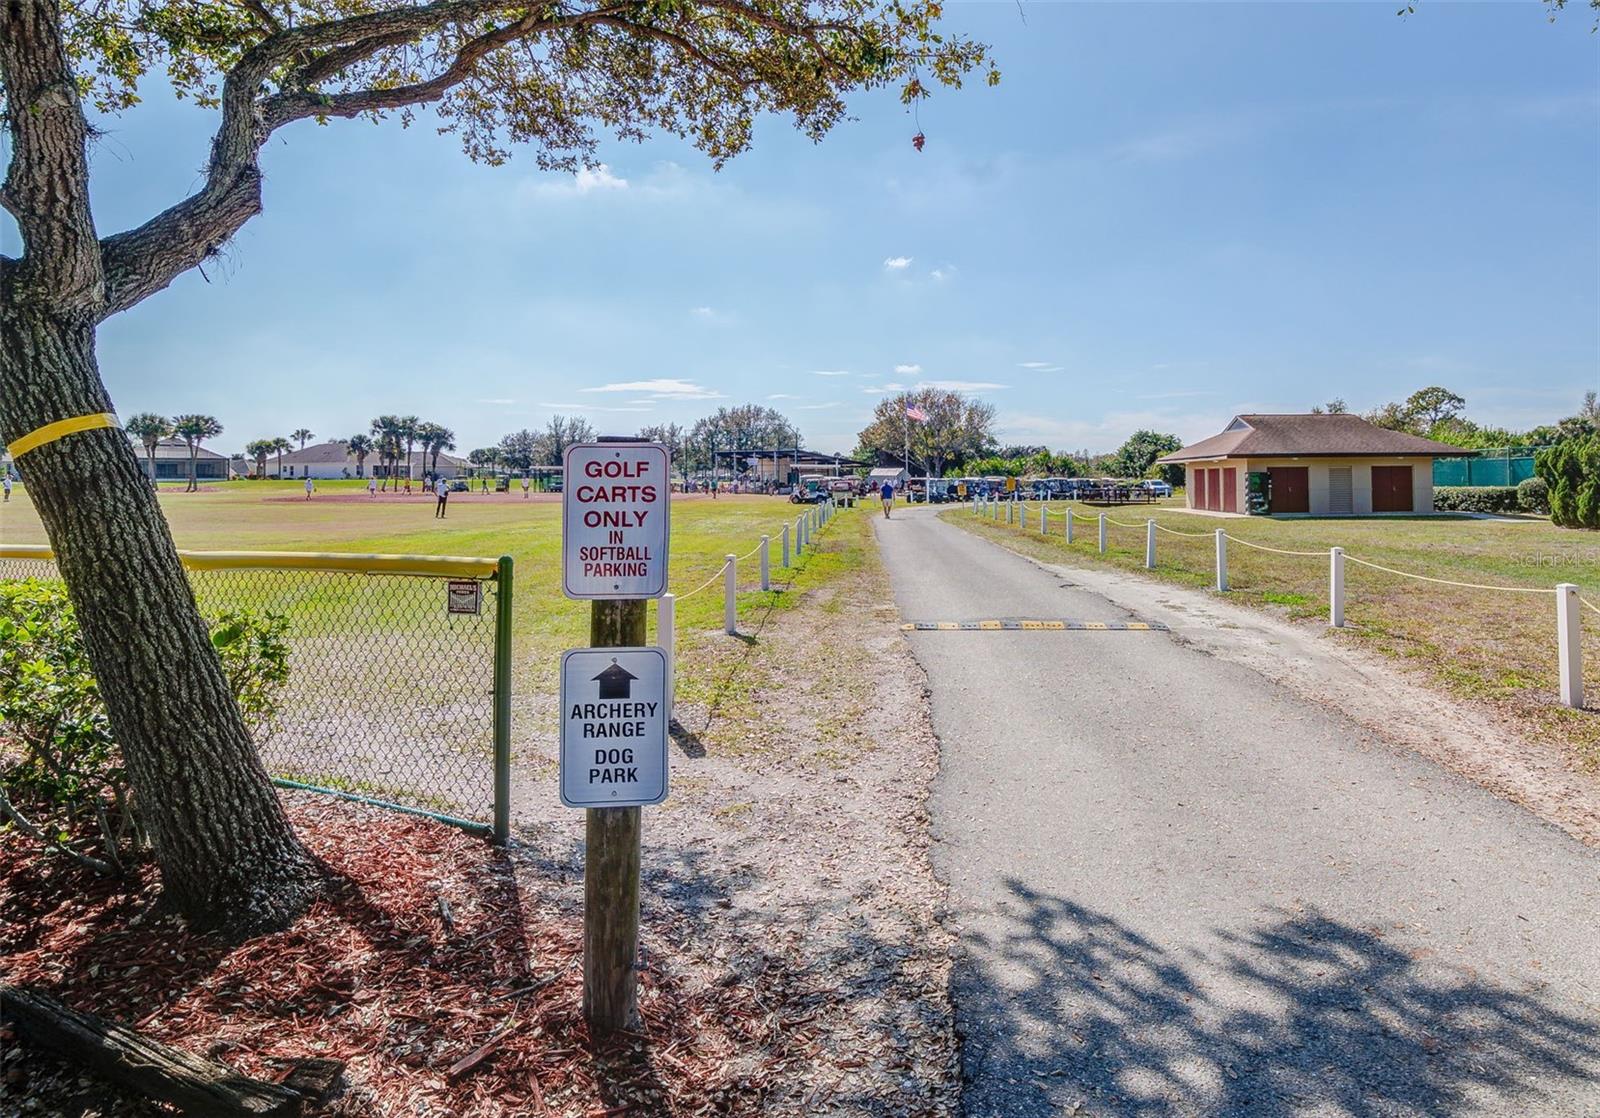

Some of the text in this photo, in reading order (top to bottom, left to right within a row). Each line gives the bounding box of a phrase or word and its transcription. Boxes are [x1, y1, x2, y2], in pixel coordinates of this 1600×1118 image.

[585, 461, 649, 478] GOLF
[576, 485, 657, 503] CARTS
[583, 510, 649, 528] ONLY
[609, 530, 623, 545] IN
[580, 546, 652, 561] SOFTBALL
[583, 562, 647, 577] PARKING
[570, 702, 658, 720] ARCHERY
[583, 721, 646, 739] RANGE
[595, 748, 634, 765] DOG
[589, 767, 638, 784] PARK
